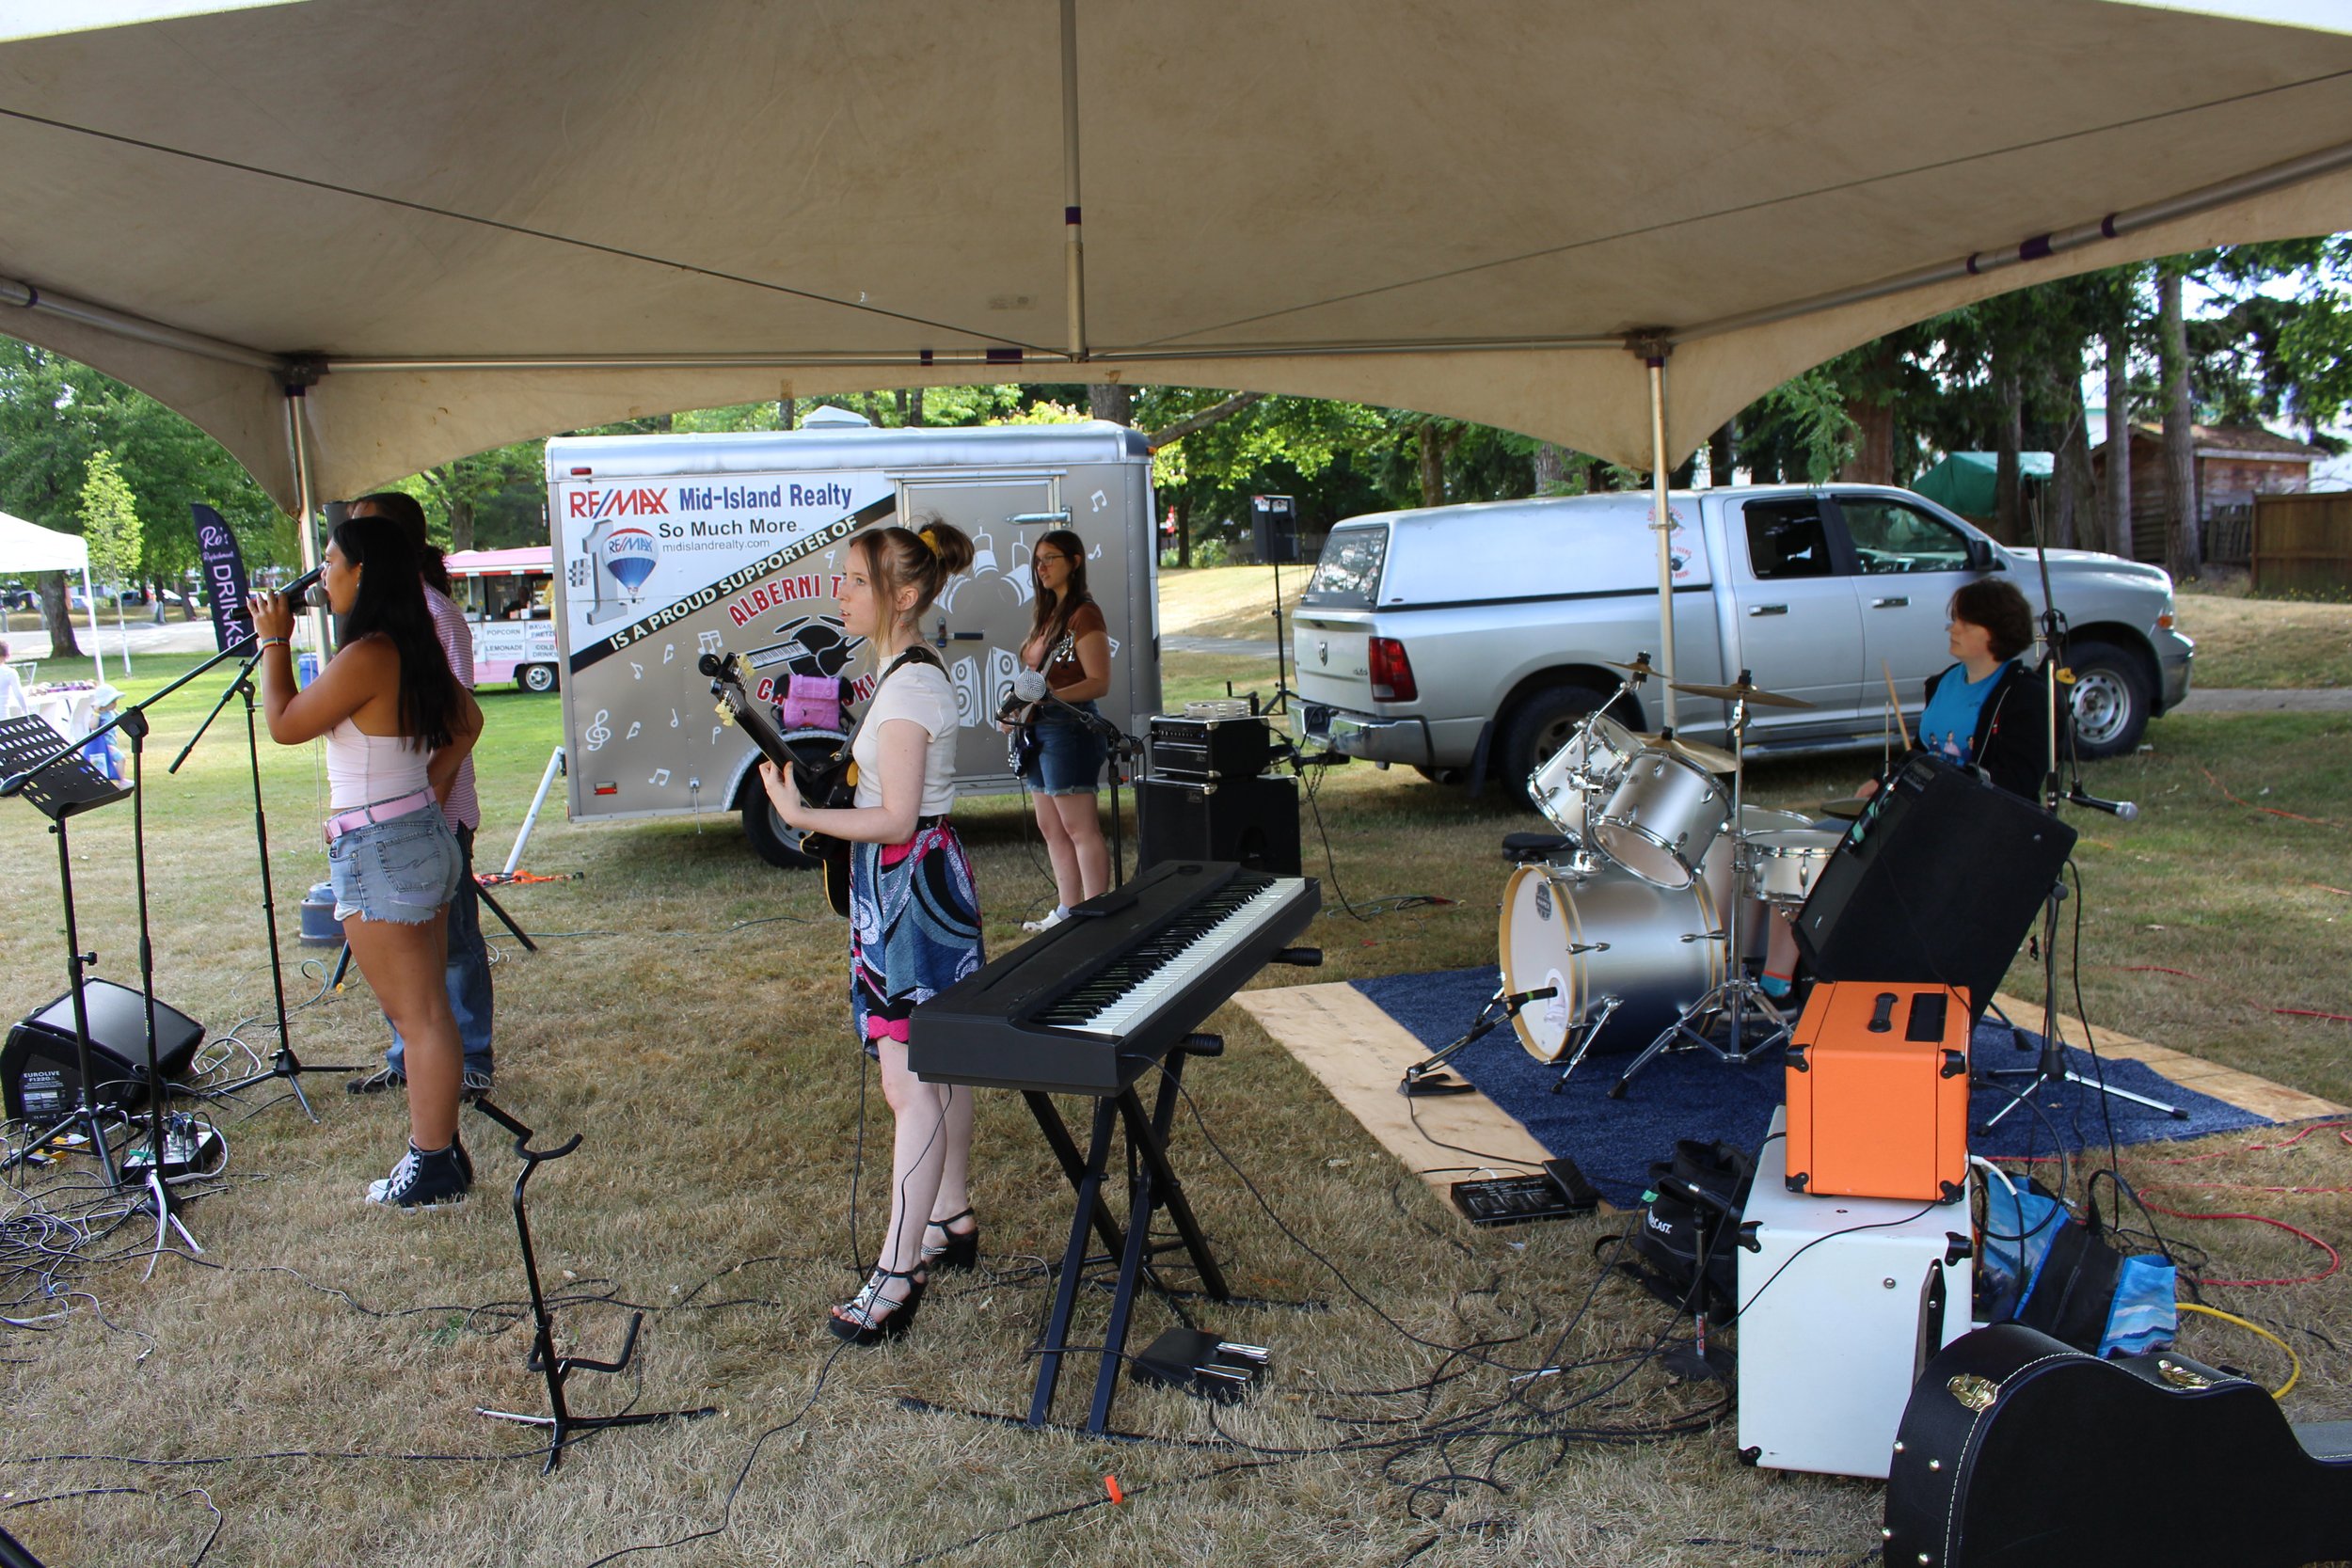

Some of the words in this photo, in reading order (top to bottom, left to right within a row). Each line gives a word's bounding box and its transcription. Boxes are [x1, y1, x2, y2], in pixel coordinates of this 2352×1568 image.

[569, 487, 670, 519] RE/MAX
[679, 484, 782, 511] Mid-Island
[789, 483, 852, 510] Realty
[659, 522, 684, 538] So
[691, 519, 742, 537] Much
[750, 518, 797, 533] More
[609, 536, 653, 554] RE/MAX
[662, 538, 771, 553] midislandrealty.com
[610, 633, 630, 651] IS
[633, 624, 648, 641] A
[648, 589, 717, 631] PROUD
[719, 531, 831, 595] SUPPORTER
[831, 515, 859, 538] OF
[728, 574, 821, 628] ALBERNI
